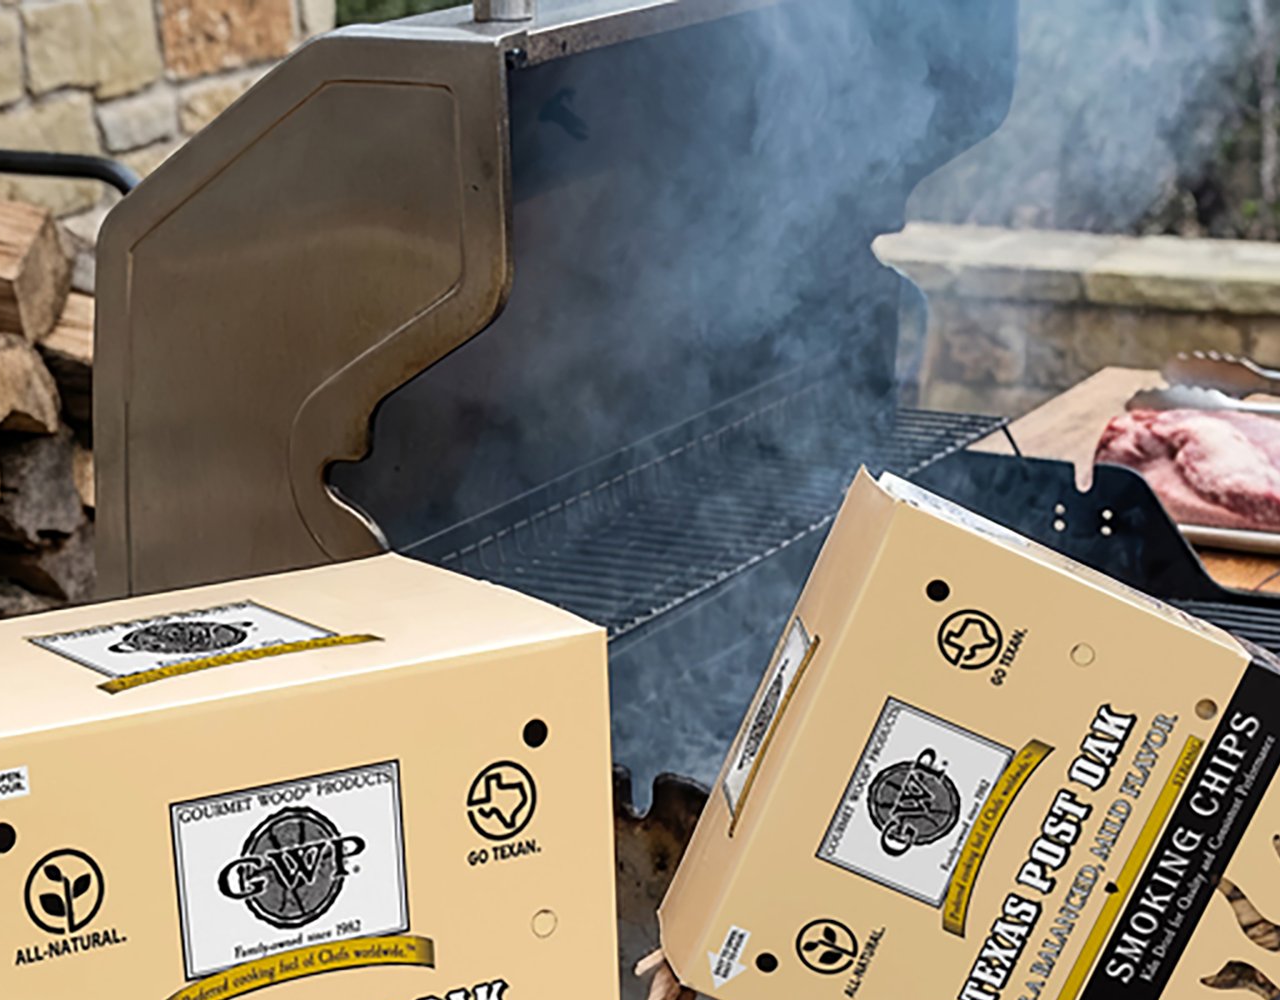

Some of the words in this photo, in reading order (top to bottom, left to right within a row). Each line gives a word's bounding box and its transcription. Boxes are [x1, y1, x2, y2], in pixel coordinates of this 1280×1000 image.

[178, 796, 253, 824] GOURMET
[316, 770, 393, 797] PRODUCTS
[1015, 787, 1094, 895] POST
[1067, 703, 1138, 793] OAK
[466, 849, 489, 866] GO
[491, 838, 542, 860] TEXAN.
[1090, 797, 1133, 862] MILD
[1104, 825, 1203, 985] SMOKING
[1189, 710, 1262, 817] CHIPS
[14, 928, 128, 966] ALL-NATURAL.
[233, 965, 276, 989] cooking
[302, 955, 315, 968] of
[318, 946, 350, 965] Chefs
